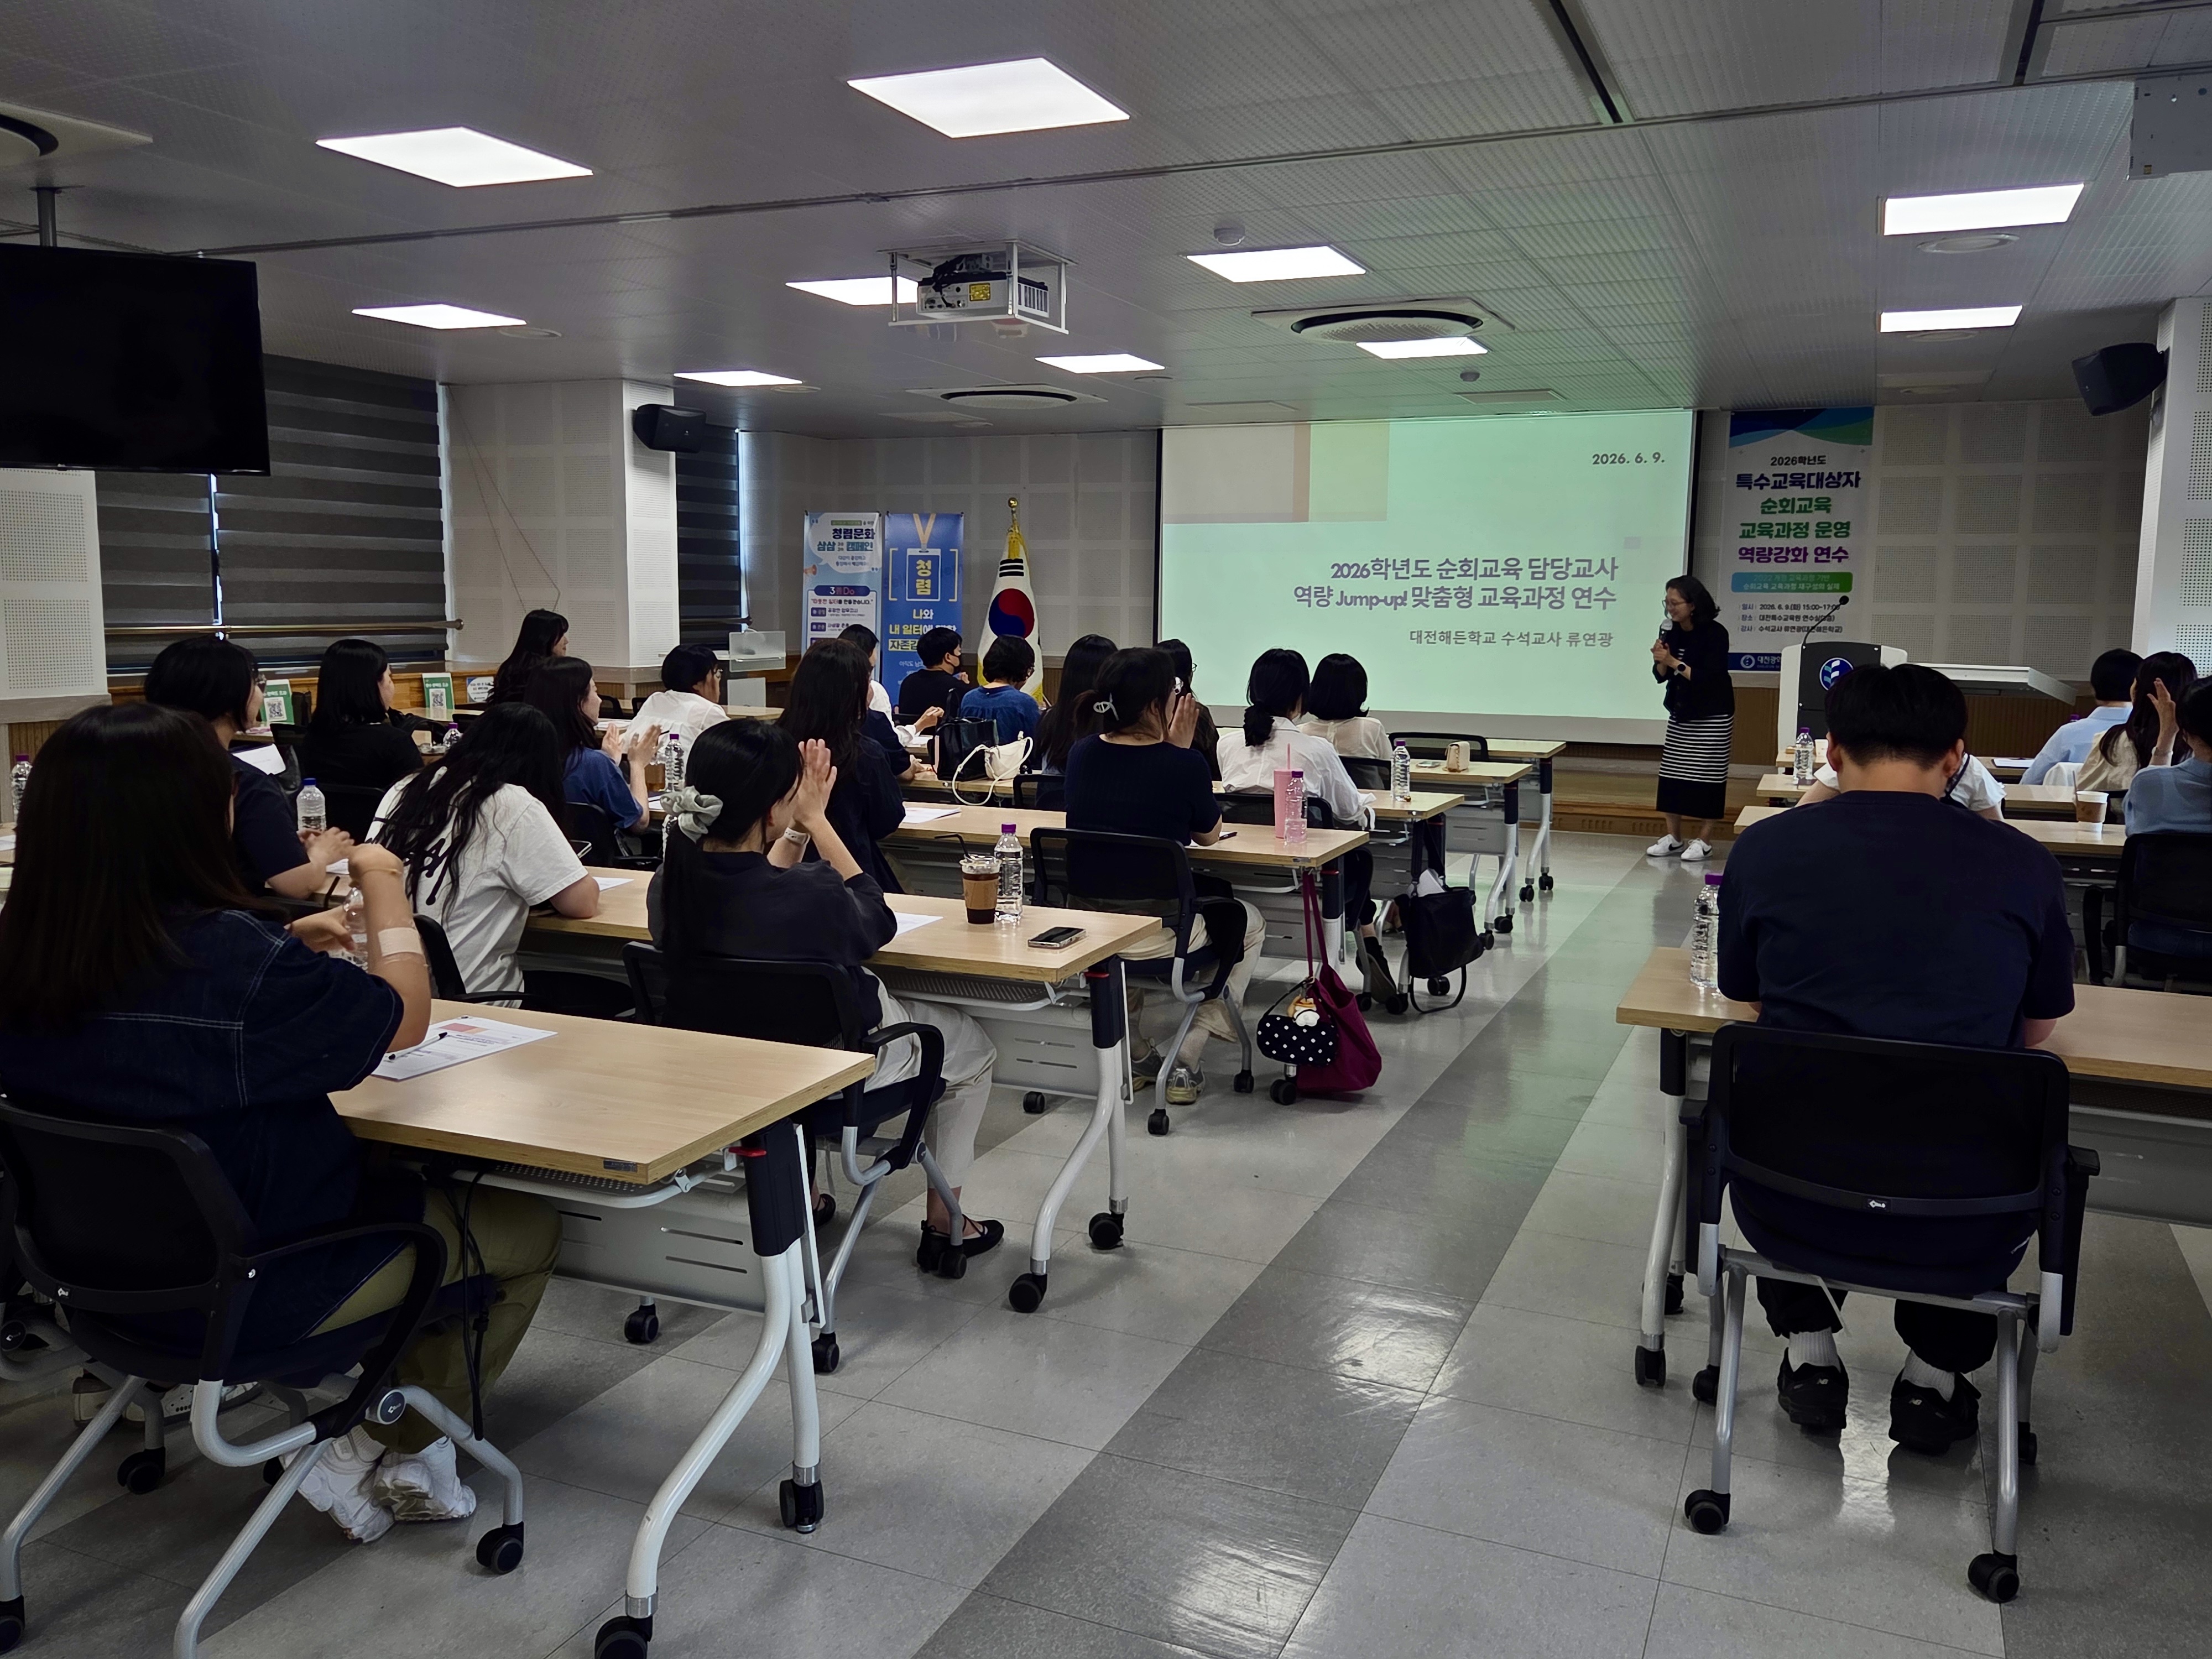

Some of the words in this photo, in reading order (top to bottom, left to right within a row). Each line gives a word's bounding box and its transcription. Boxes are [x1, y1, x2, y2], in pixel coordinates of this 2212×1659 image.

[1592, 453, 1630, 465] 2026.
[1635, 452, 1647, 465] 6.
[1652, 452, 1665, 464] 9.
[1771, 455, 1826, 466] 2026학년도
[1736, 471, 1861, 490] 특수교육대상자
[1760, 497, 1832, 514] 순회교육
[832, 528, 875, 539] 청렴문화
[1739, 521, 1809, 539] 교육과정
[1815, 521, 1850, 538] 운영
[817, 541, 836, 551] 삼삼
[846, 541, 873, 551] 캠페인
[1738, 546, 1809, 564] 역량강화
[1814, 546, 1849, 563] 연수
[916, 559, 932, 596] 청렴
[1331, 557, 1432, 581] 2026학년도
[1436, 557, 1524, 581] 순회교육
[1528, 557, 1619, 581] 담당교사
[1293, 585, 1334, 608] 역량
[1335, 589, 1408, 611] Jump-up!
[1411, 585, 1474, 609] 맞춤형
[1478, 586, 1566, 610] 교육과정
[1572, 586, 1617, 610] 연수
[913, 609, 933, 619] 나와
[889, 624, 899, 634] 내
[902, 624, 933, 635] 일터에
[1410, 630, 1496, 646] 대전해든학교
[1500, 631, 1562, 647] 수석교사
[1566, 632, 1614, 648] 류연광
